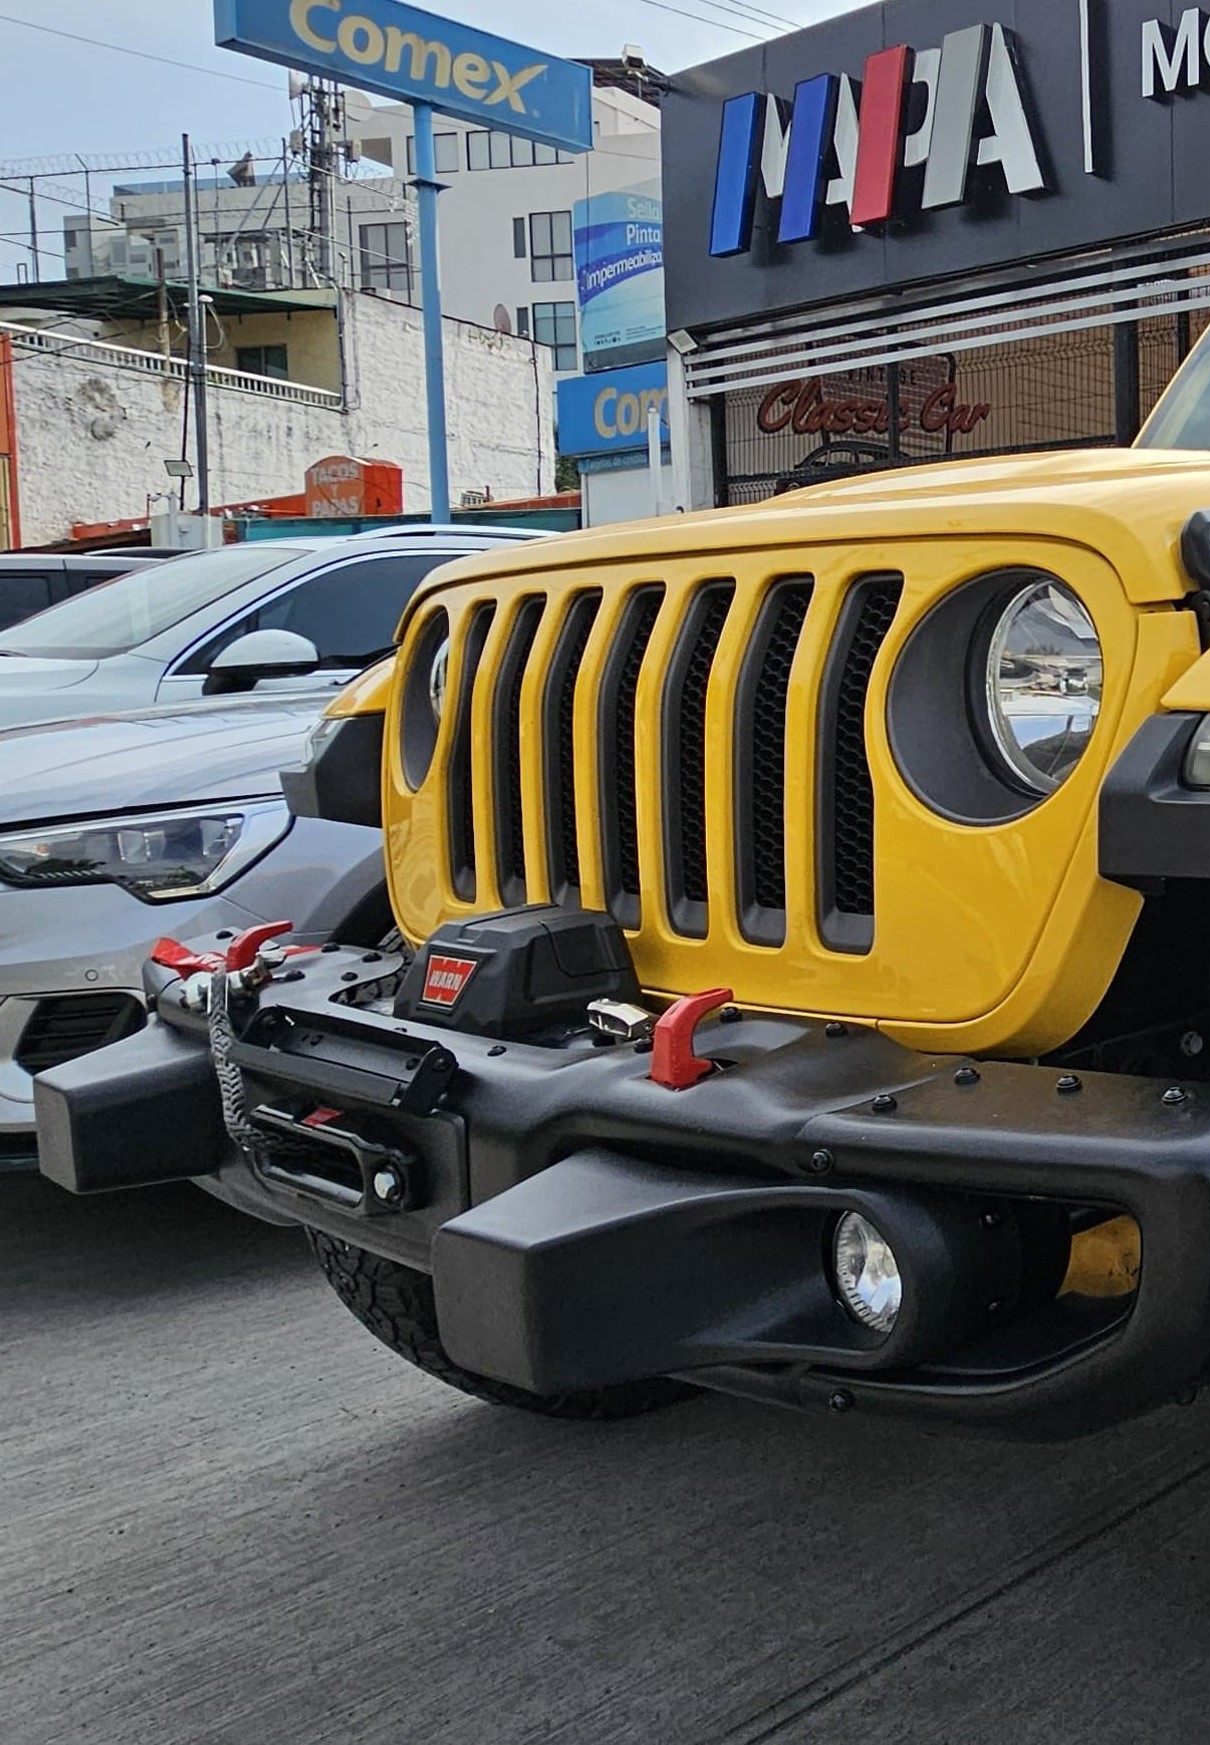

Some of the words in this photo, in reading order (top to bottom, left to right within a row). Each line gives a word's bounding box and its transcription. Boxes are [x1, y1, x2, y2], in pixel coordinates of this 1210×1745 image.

[289, 0, 549, 114] Comex
[627, 198, 660, 219] Sella
[626, 224, 661, 246] Pinta
[920, 382, 990, 434] Car
[310, 462, 359, 486] TACOS
[312, 496, 360, 517] PAPAS
[428, 969, 463, 992] WARN
